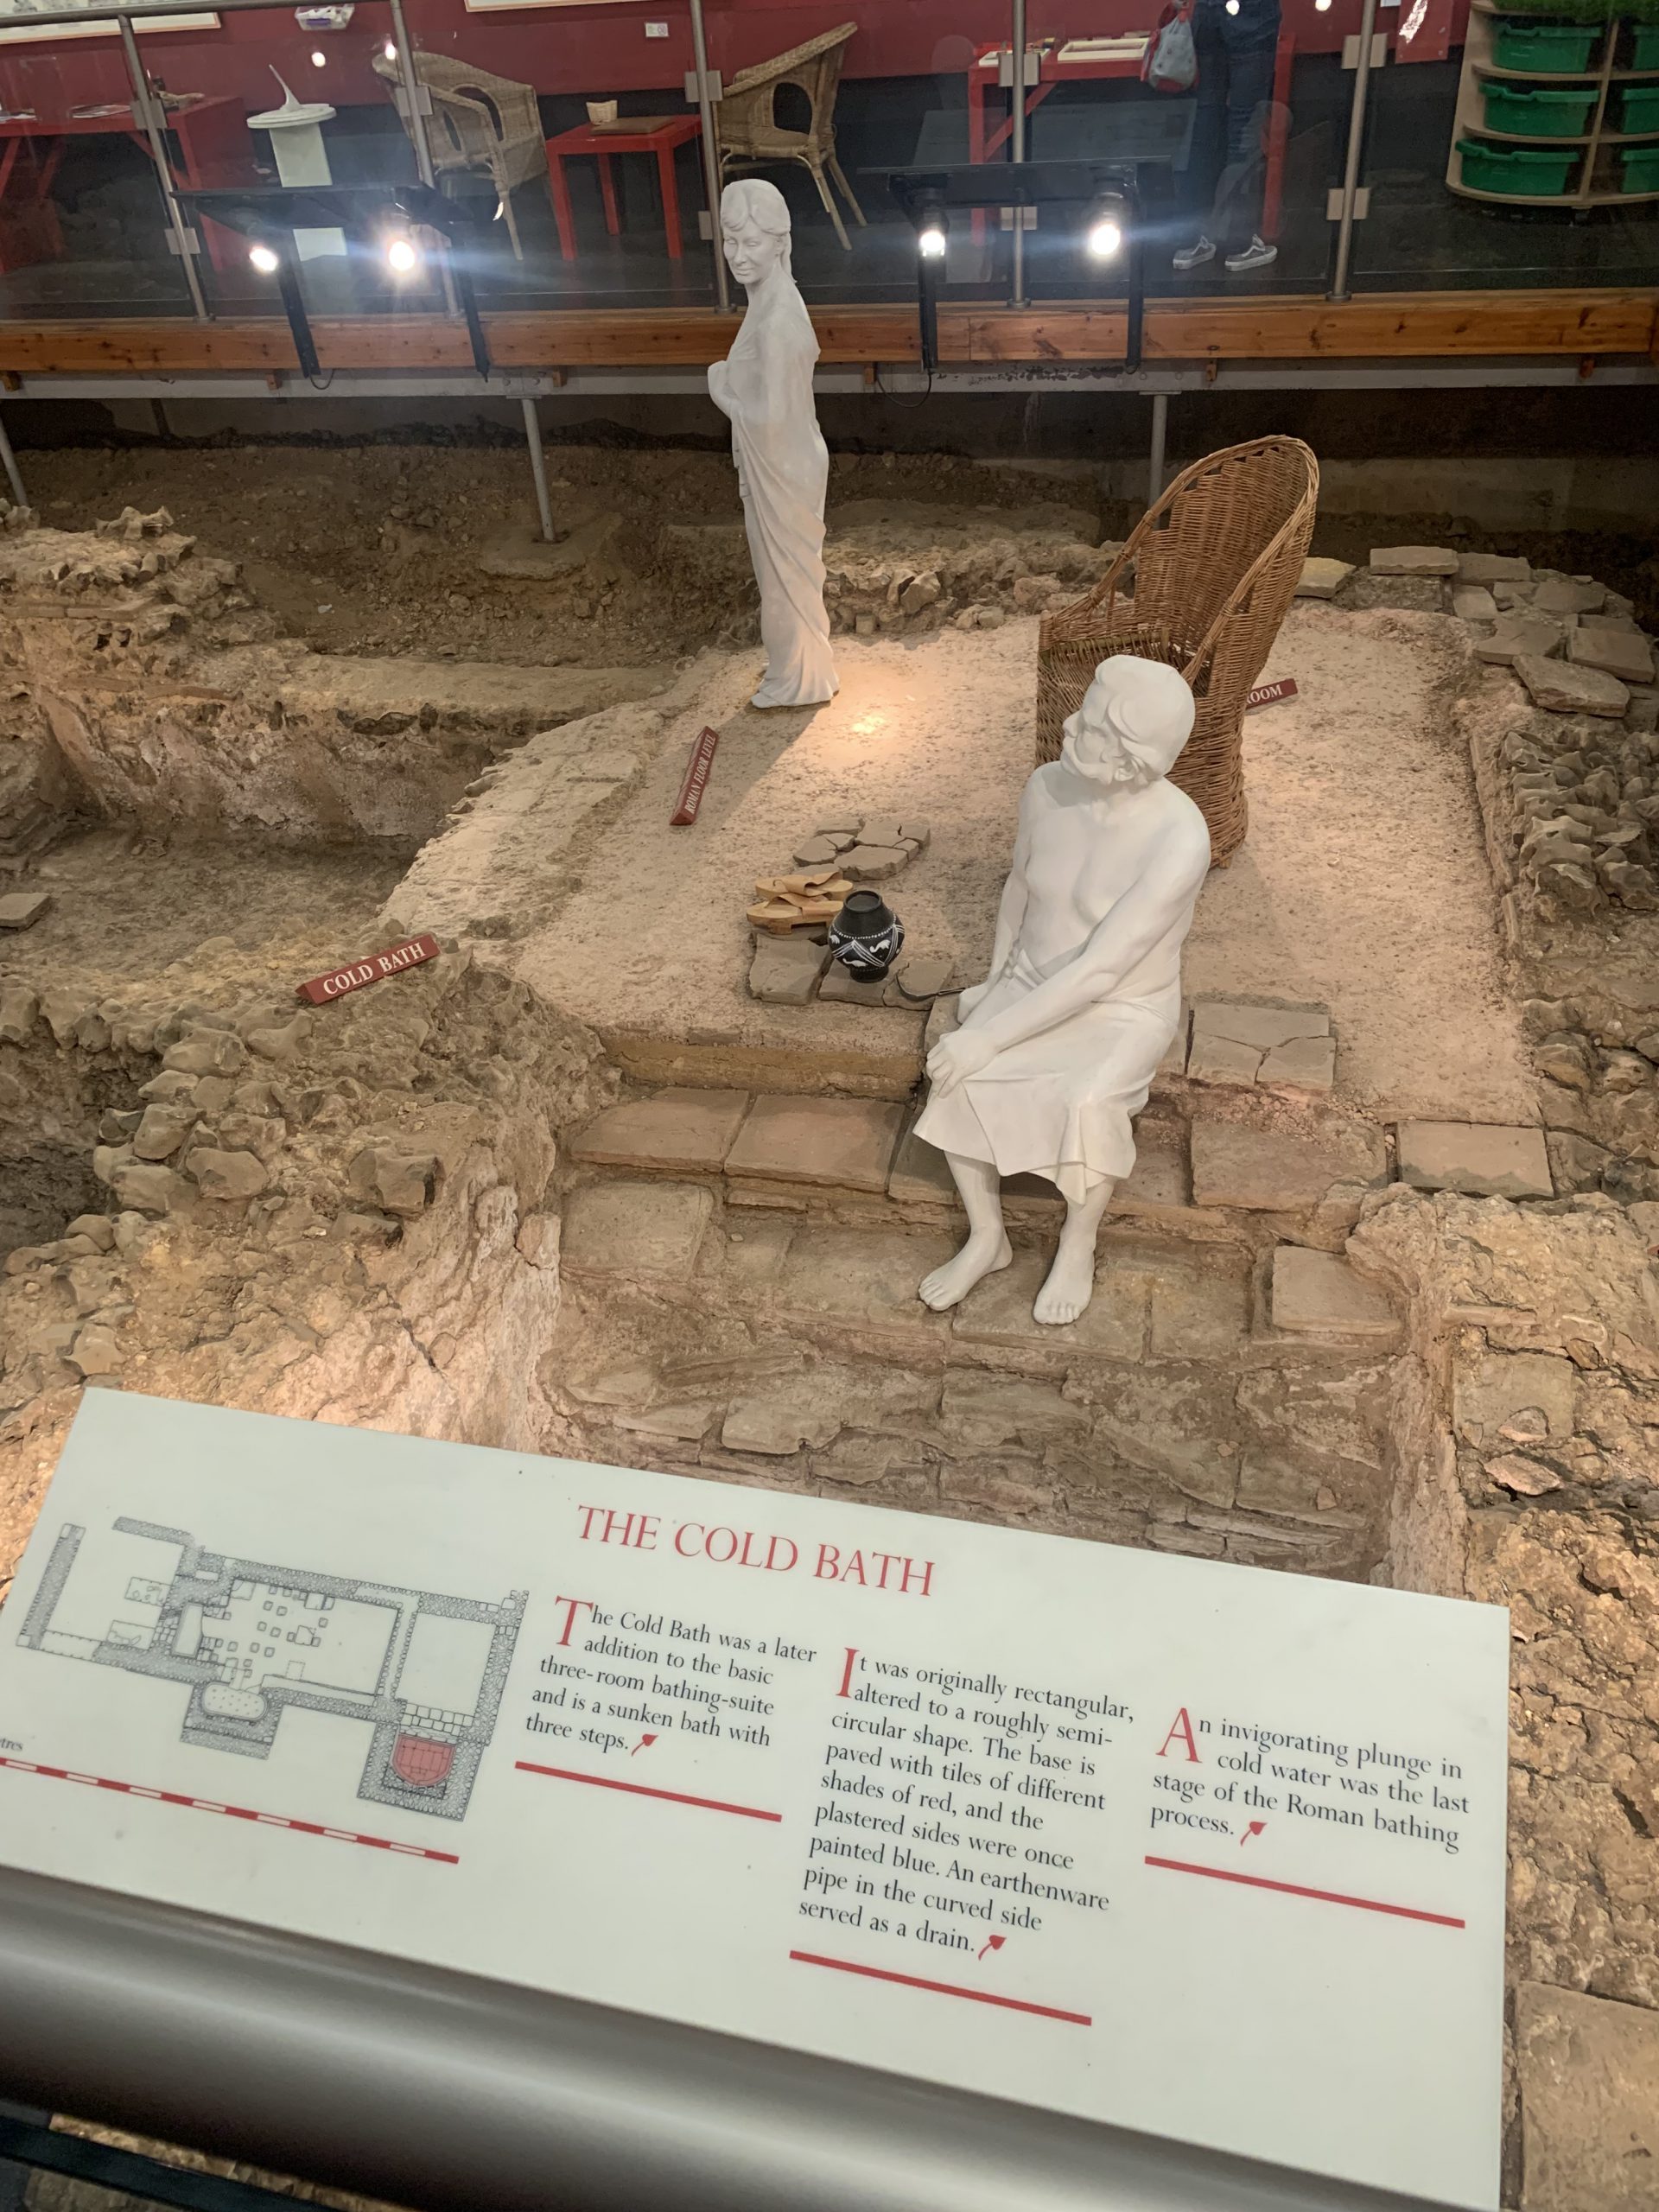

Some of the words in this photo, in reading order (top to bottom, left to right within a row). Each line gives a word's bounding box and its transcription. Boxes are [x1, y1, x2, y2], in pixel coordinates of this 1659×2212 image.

[684, 782, 702, 815] ROMAN
[693, 756, 709, 785] FLOOR
[701, 734, 716, 759] LEVEL
[323, 964, 373, 995] COLD
[377, 943, 427, 973] BATH
[577, 1504, 661, 1551] THE
[674, 1522, 798, 1572] COLD
[813, 1543, 936, 1597] BATH
[555, 1595, 613, 1647] The
[620, 1611, 664, 1635] Cold
[669, 1620, 710, 1643] Bath
[719, 1634, 751, 1650] was
[758, 1642, 766, 1654] a
[774, 1637, 817, 1662] later
[584, 1635, 658, 1663] addition
[667, 1652, 684, 1669] to
[692, 1653, 721, 1675] the
[728, 1658, 773, 1685] basic
[532, 1688, 567, 1707] and
[571, 1693, 586, 1710] is
[592, 1701, 601, 1713] a
[607, 1703, 673, 1727] sunken
[680, 1711, 721, 1737] bath
[728, 1726, 770, 1746] with
[652, 1675, 774, 1715] bathing-suite
[836, 1647, 868, 1698] It
[875, 1662, 909, 1679] was
[916, 1668, 1007, 1703] originally
[1014, 1687, 1134, 1724] rectangular,
[855, 1683, 921, 1712] altered
[928, 1699, 948, 1717] to
[956, 1707, 964, 1719] a
[974, 1709, 1050, 1742] roughly
[1056, 1726, 1112, 1745] semi-
[0, 1738, 23, 1751] tres
[525, 1713, 572, 1738] three
[579, 1727, 628, 1753] steps.
[831, 1712, 906, 1739] circular
[913, 1724, 973, 1756] shape.
[983, 1736, 1021, 1761] The
[1029, 1745, 1071, 1770] base
[1080, 1756, 1095, 1776] is
[1155, 1707, 1211, 1764] An
[1221, 1718, 1349, 1767] invigorating
[1357, 1742, 1431, 1780] plunge
[1441, 1758, 1462, 1779] in
[821, 1770, 885, 1799] shades
[892, 1784, 915, 1803] of
[919, 1791, 957, 1817] red,
[965, 1802, 1002, 1822] and
[1011, 1806, 1044, 1830] the
[825, 1745, 882, 1766] paved
[890, 1755, 933, 1777] with
[943, 1762, 982, 1786] tiles
[989, 1771, 1014, 1791] of
[1017, 1775, 1106, 1809] different
[1217, 1751, 1262, 1775] cold
[1271, 1764, 1332, 1787] water
[1340, 1777, 1378, 1796] was
[1388, 1779, 1423, 1804] the
[1433, 1786, 1470, 1814] last
[814, 1801, 905, 1835] plastered
[912, 1821, 960, 1847] sides
[969, 1837, 1017, 1858] were
[1025, 1847, 1074, 1870] once
[1150, 1806, 1234, 1835] process.
[1153, 1774, 1205, 1803] stage
[1214, 1781, 1238, 1802] of
[1244, 1785, 1278, 1809] the
[1287, 1793, 1363, 1827] Roman
[1375, 1808, 1459, 1854] bathing
[803, 1866, 848, 1894] pipe
[855, 1874, 874, 1896] in
[884, 1879, 916, 1904] the
[924, 1894, 993, 1921] curved
[1001, 1906, 1042, 1930] side
[809, 1836, 886, 1864] painted
[893, 1846, 940, 1876] blue.
[945, 1859, 974, 1883] An
[980, 1872, 1109, 1910] earthenware
[798, 1901, 863, 1927] served
[869, 1916, 889, 1932] as
[897, 1923, 906, 1936] a
[916, 1919, 975, 1951] drain.
